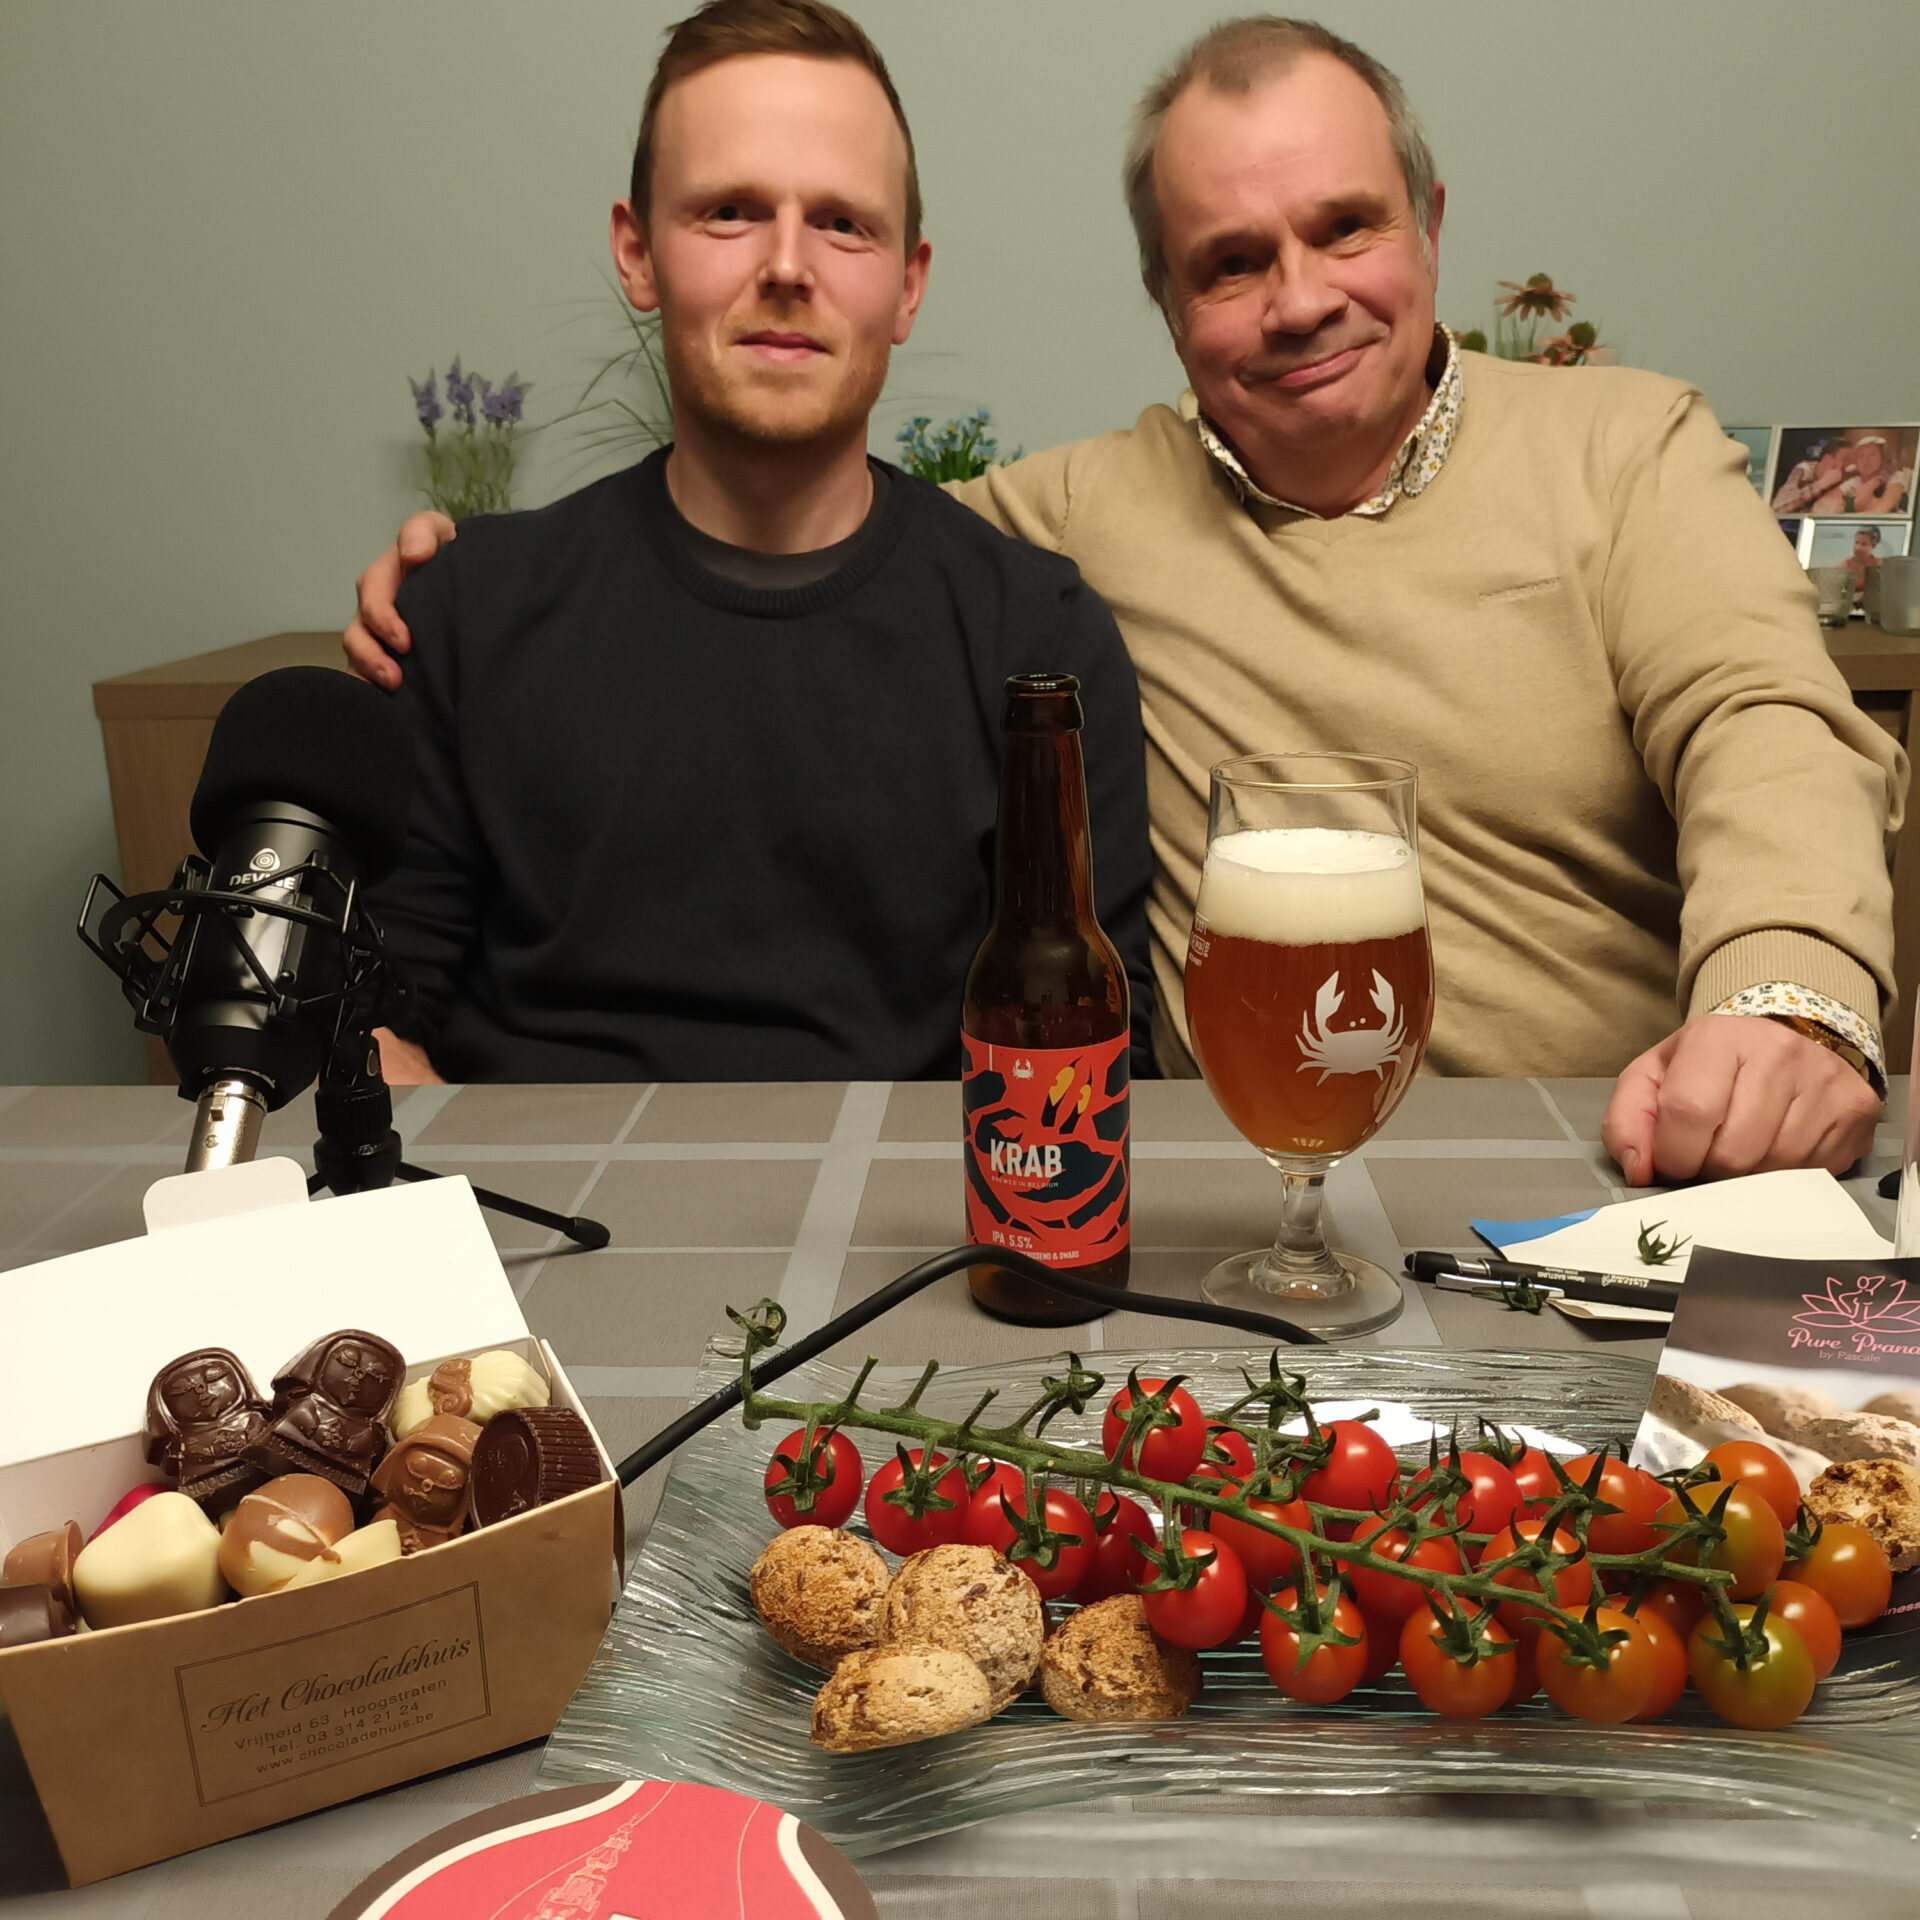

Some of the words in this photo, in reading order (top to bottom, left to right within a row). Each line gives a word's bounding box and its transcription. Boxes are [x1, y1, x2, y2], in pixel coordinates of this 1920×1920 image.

[990, 1137, 1062, 1178] KRAB
[991, 1174, 1018, 1187] BREWED
[1027, 1181, 1059, 1189] BELGIUM
[992, 1229, 1005, 1244] IPA
[1008, 1234, 1033, 1249] 5.5%
[1787, 1327, 1842, 1349] Pure
[1851, 1332, 1920, 1355] Prana
[1819, 1350, 1834, 1360] by
[1838, 1350, 1881, 1362] Pascale
[201, 1692, 270, 1733] Het
[281, 1638, 471, 1711] Chocoladehuis
[234, 1722, 302, 1750] Vrijheid
[309, 1714, 330, 1729] 63
[343, 1679, 447, 1719] Hoogstraten
[267, 1740, 299, 1755] Tel.
[307, 1730, 328, 1744] 03
[335, 1719, 365, 1736] 314
[372, 1711, 391, 1725] 21
[399, 1701, 420, 1715] 24
